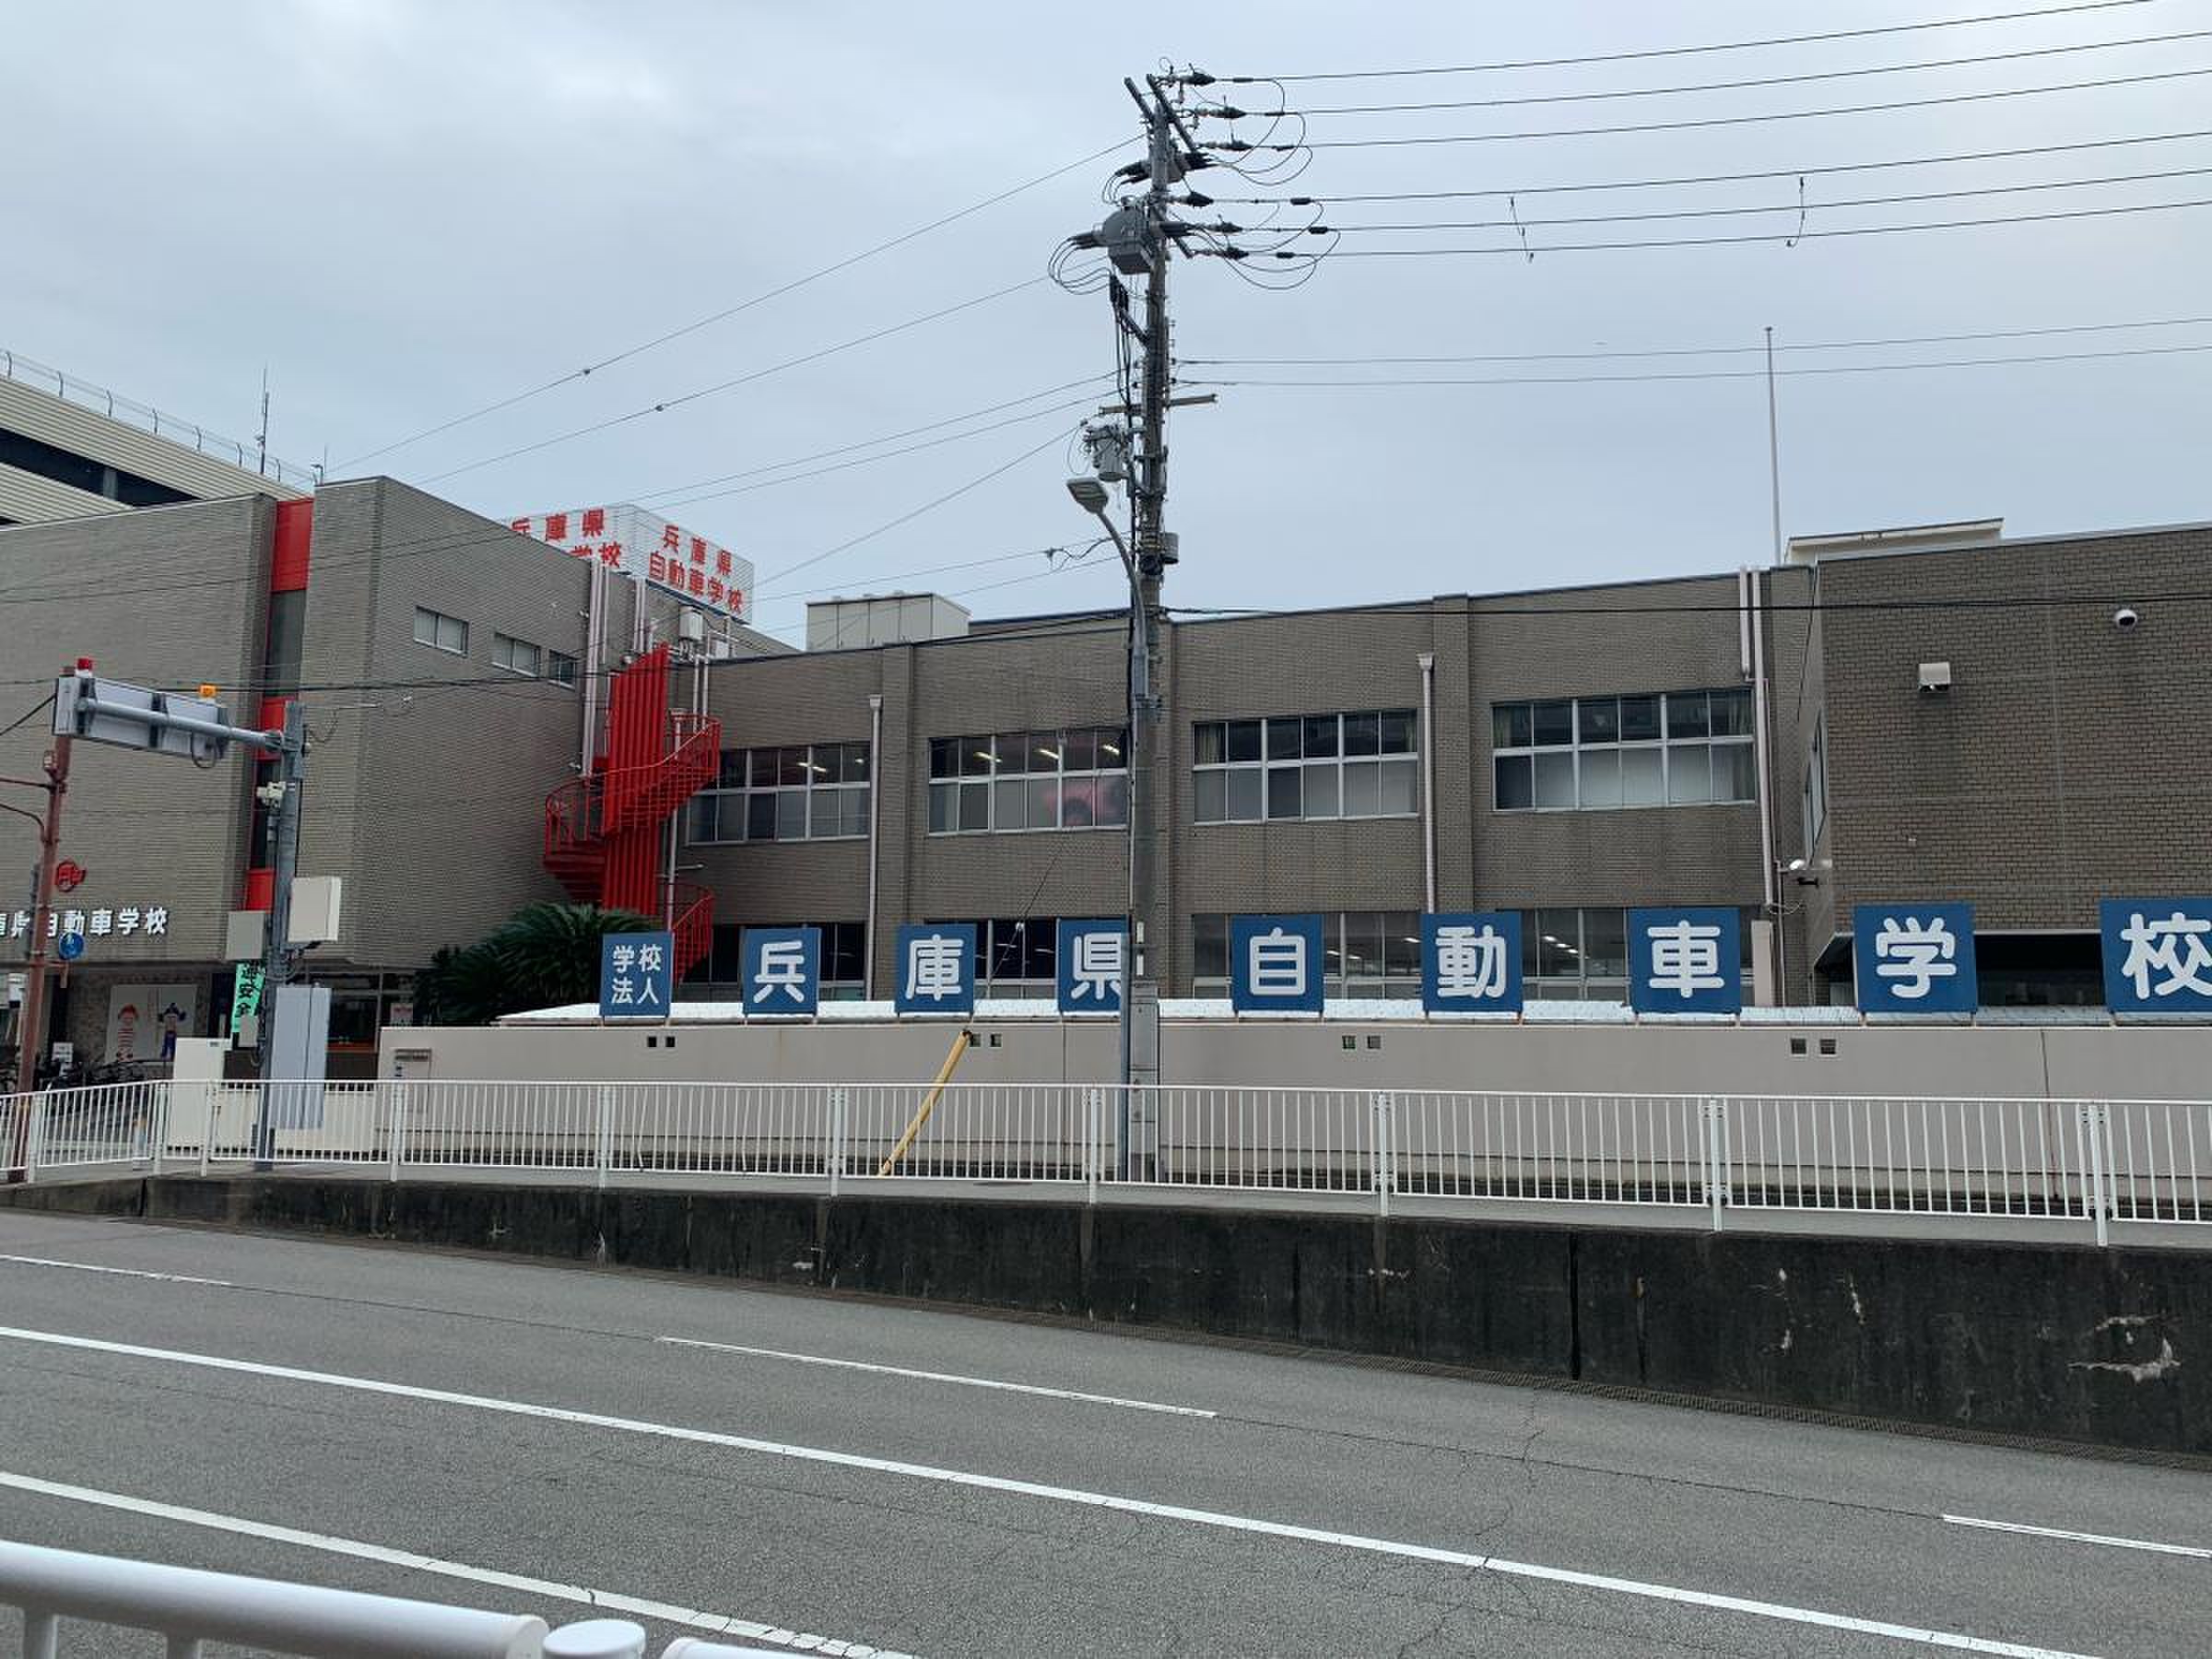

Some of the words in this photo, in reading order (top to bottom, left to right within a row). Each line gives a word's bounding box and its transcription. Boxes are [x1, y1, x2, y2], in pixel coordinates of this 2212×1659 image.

[664, 524, 732, 576] 兵庫県
[649, 550, 743, 614] 自動車学校
[612, 943, 663, 973] 学校
[611, 977, 660, 1005] 法人
